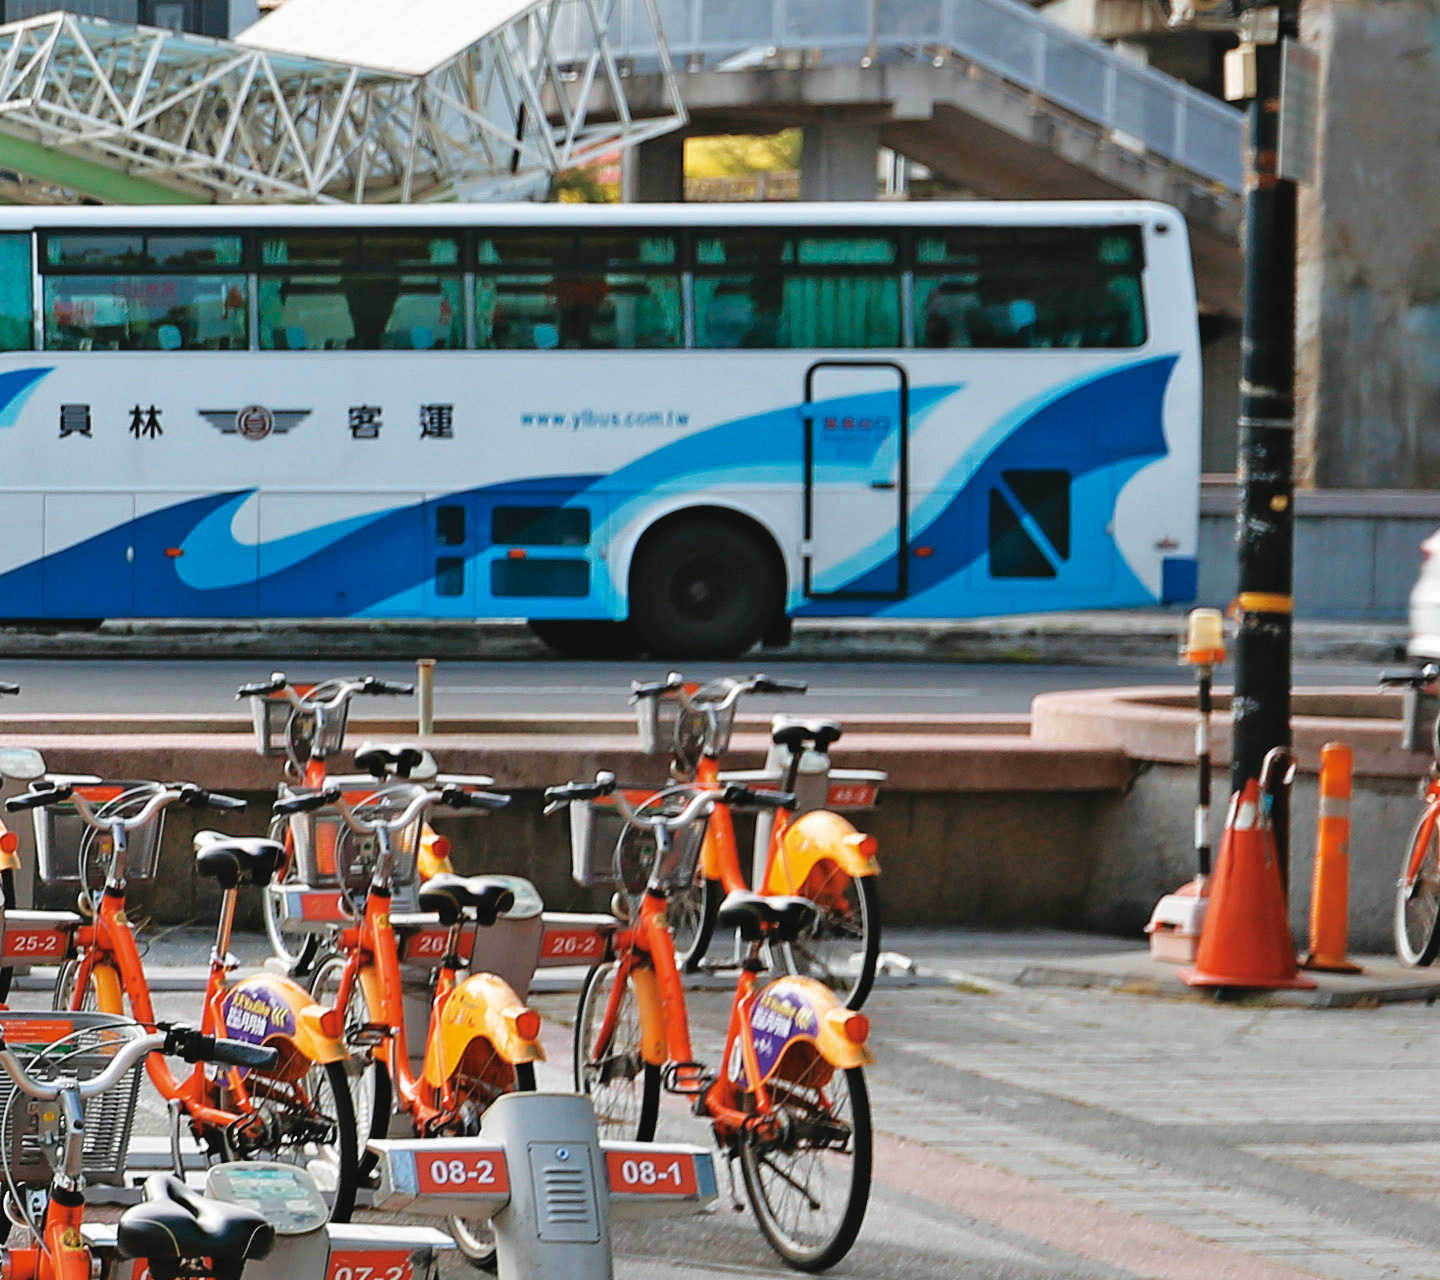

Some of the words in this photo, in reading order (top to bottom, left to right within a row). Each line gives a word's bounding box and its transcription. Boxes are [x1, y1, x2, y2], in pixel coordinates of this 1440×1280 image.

[58, 404, 164, 439] 員林
[348, 404, 455, 439] 客運
[14, 936, 56, 951] 25-2
[552, 937, 595, 953] 26-2
[432, 1160, 494, 1183] 08-2
[623, 1160, 681, 1183] 08-1
